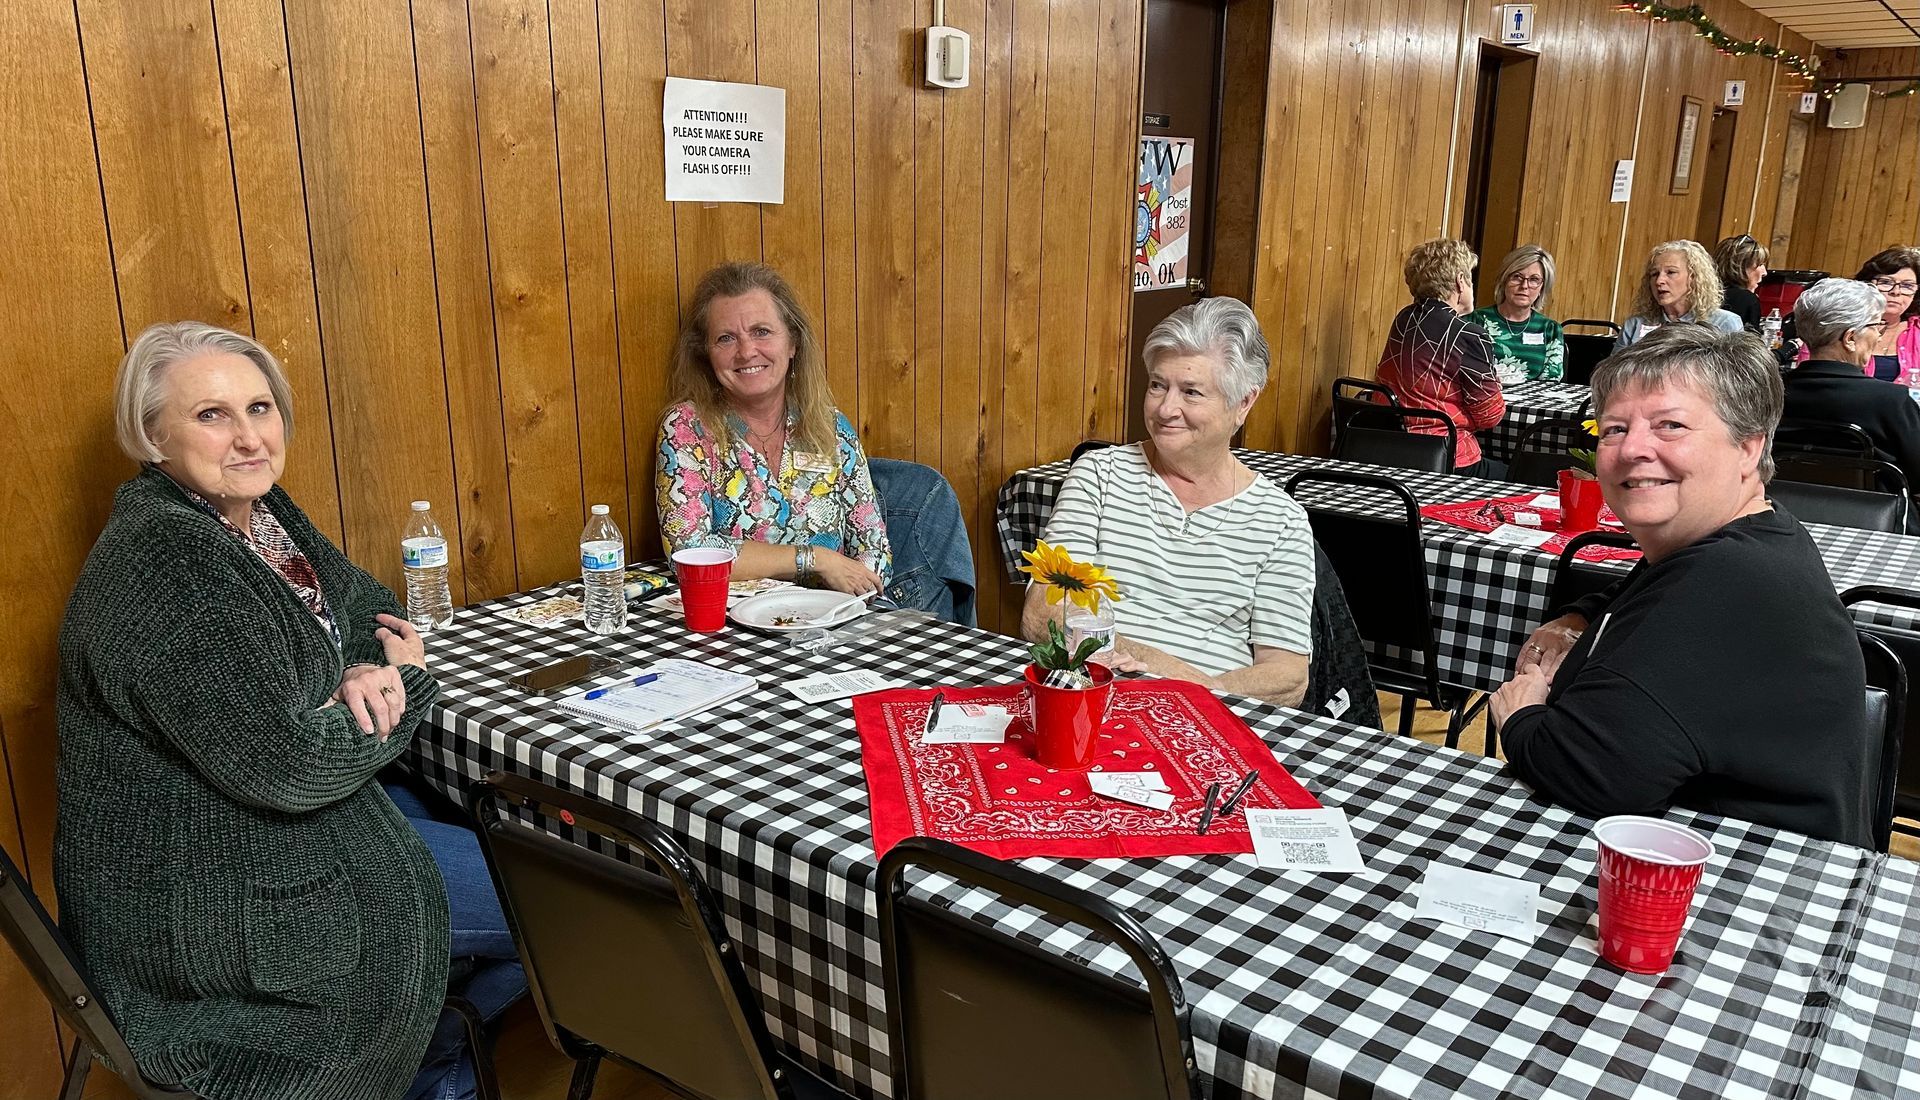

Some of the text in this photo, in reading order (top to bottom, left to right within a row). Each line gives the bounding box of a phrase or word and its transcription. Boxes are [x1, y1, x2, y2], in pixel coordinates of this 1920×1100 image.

[683, 109, 748, 124] ATTENTION!!!
[673, 126, 764, 142] PLEASE MAKE SURE
[682, 145, 751, 159] YOUR CAMERA
[683, 163, 751, 176] FLASH IS OFF!!!
[1167, 195, 1189, 209] Post
[1166, 215, 1186, 230] 382
[1158, 262, 1177, 285] OK
